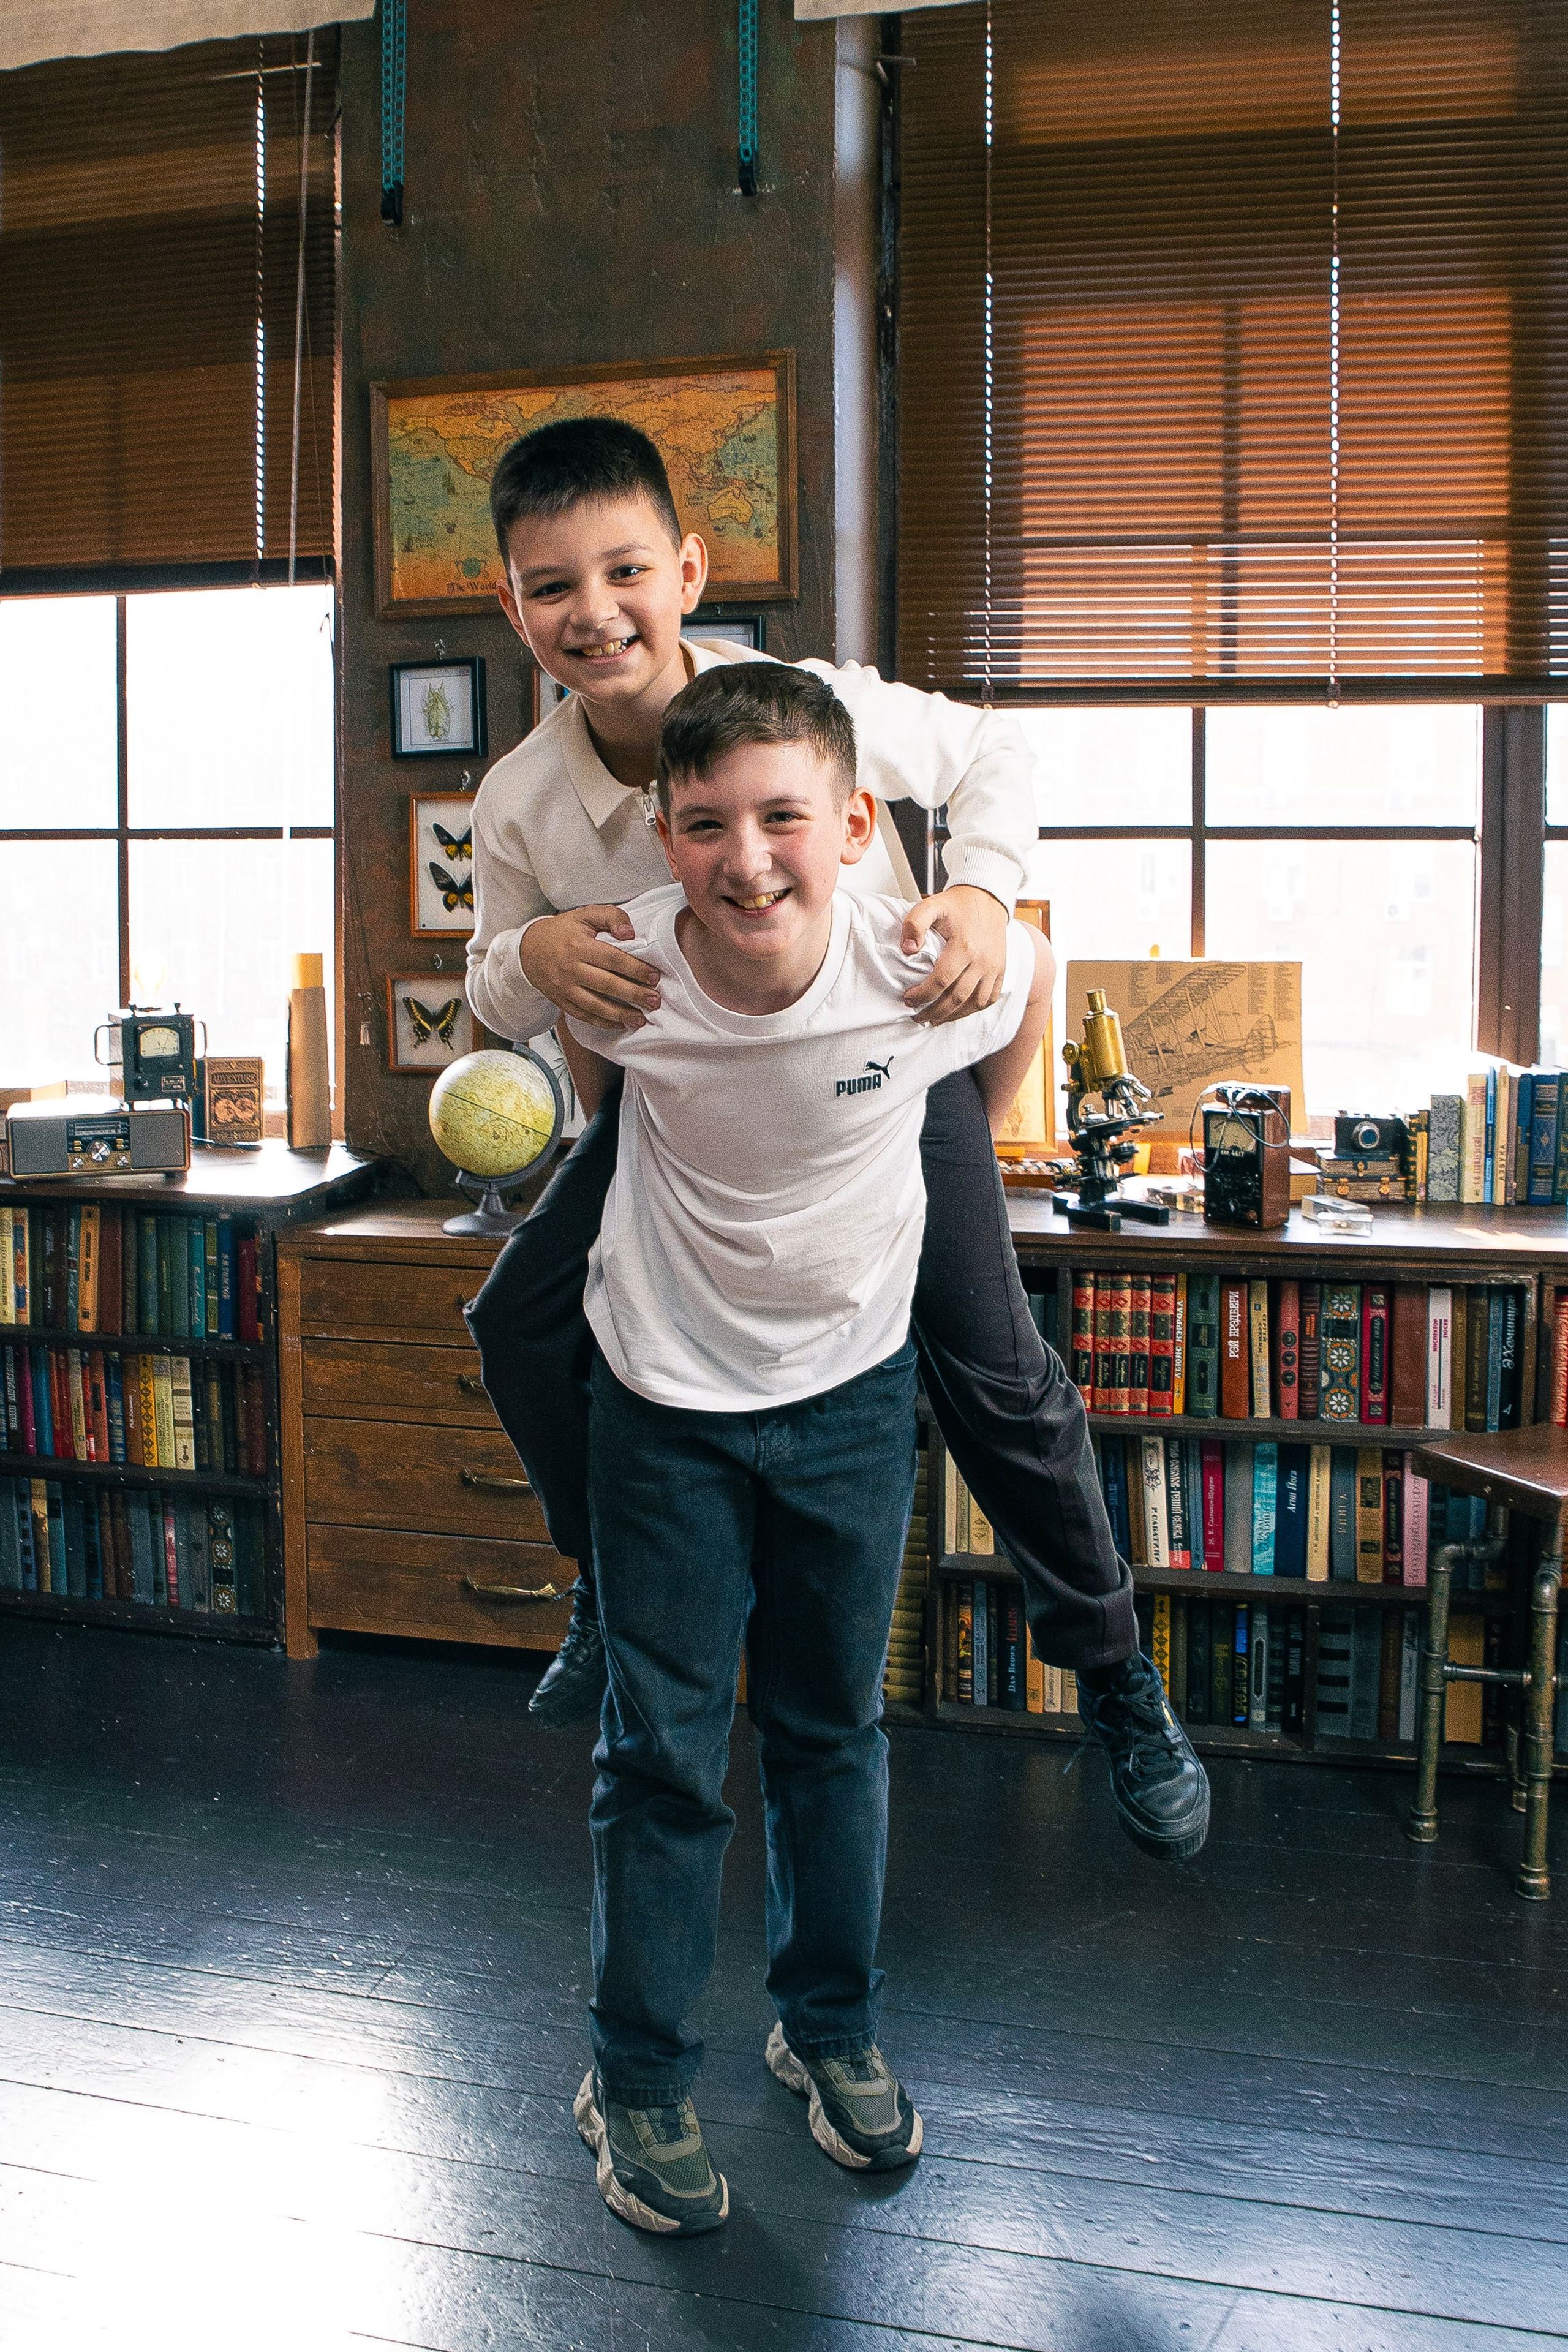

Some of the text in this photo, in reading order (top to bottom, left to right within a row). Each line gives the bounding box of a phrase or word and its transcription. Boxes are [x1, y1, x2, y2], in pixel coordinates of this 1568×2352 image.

[466, 581, 497, 592] World
[835, 1073, 882, 1097] PUMA
[1227, 1291, 1242, 1359] РЭЙ БРЭДБЕРИ
[1174, 1300, 1184, 1379] ЛЬЮИС КЭРРОЛЛ
[1170, 1490, 1183, 1515] ГЕНИЙ
[1285, 1470, 1297, 1513] Агни Йога
[1172, 1515, 1183, 1539] СЫСКА
[1288, 1647, 1301, 1675] КОНАН
